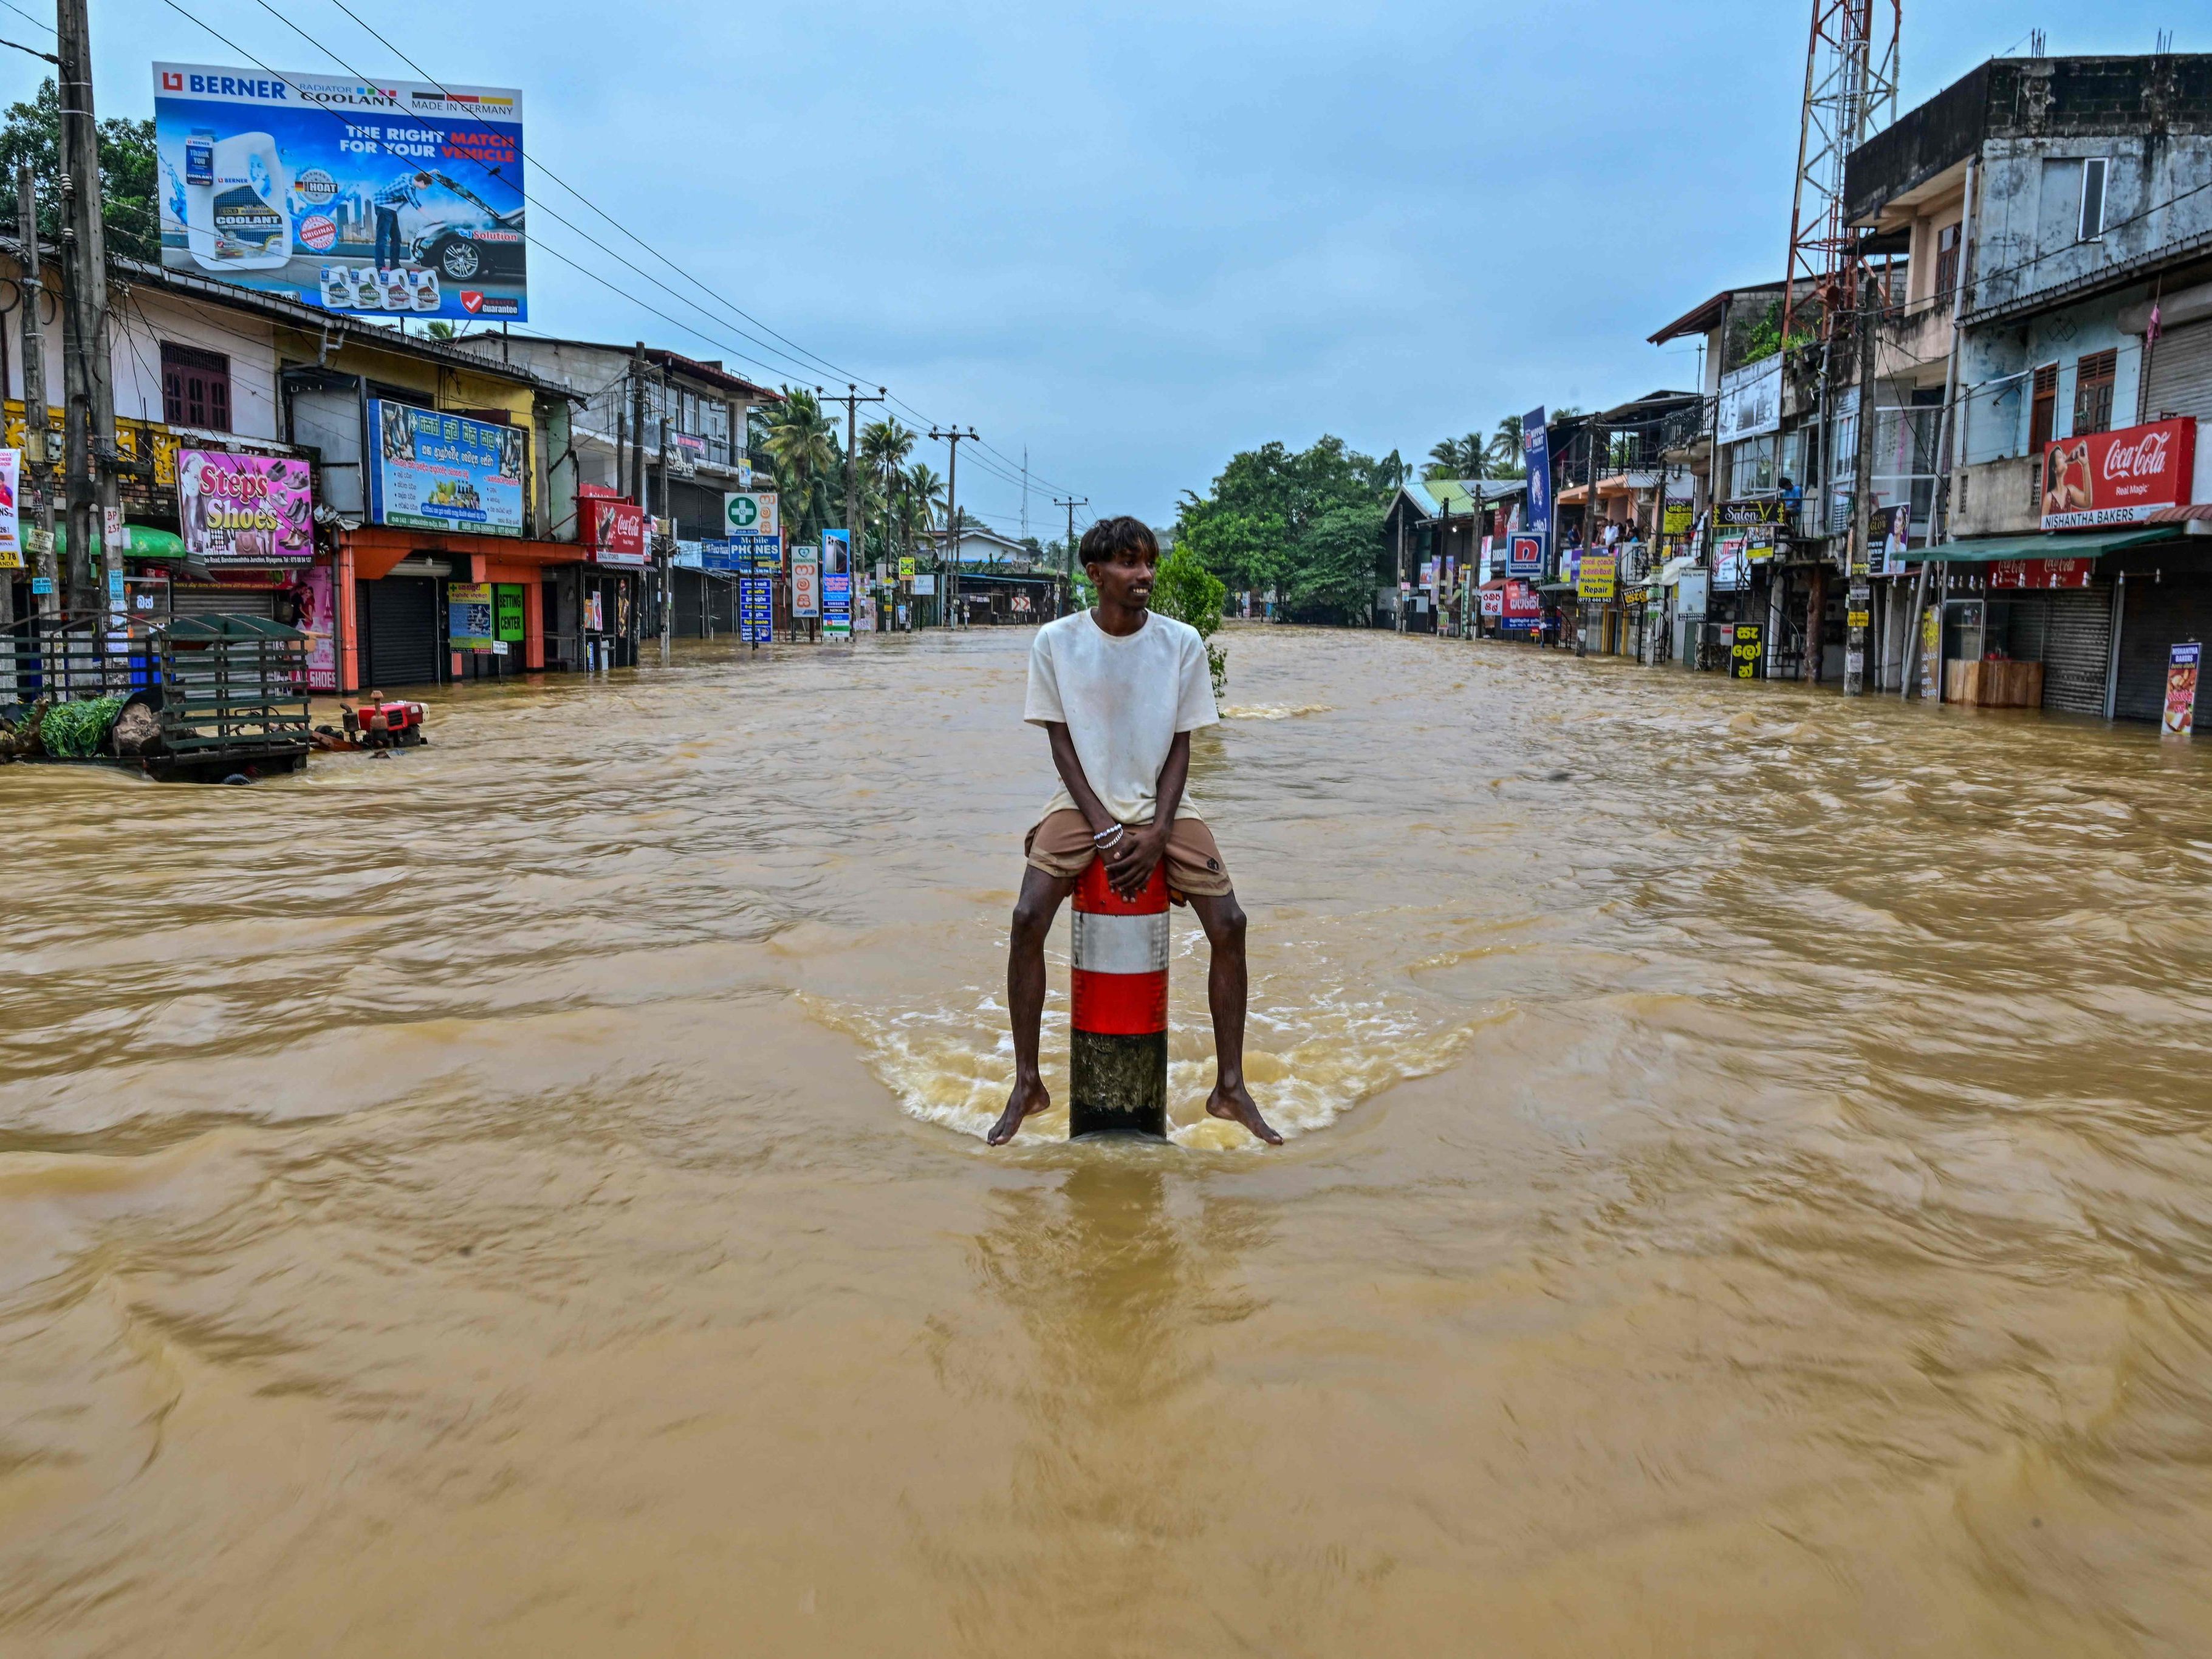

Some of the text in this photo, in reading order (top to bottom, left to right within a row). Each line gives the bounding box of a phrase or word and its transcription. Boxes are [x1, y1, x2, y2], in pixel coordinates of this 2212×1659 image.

[190, 74, 287, 100] BERNER
[300, 83, 352, 94] RADIATOR
[300, 92, 397, 107] COOLANT
[412, 100, 513, 115] MADE IN GERMANY
[346, 125, 515, 148] THE RIGHT MATCH
[340, 139, 515, 163] FOR YOUR VEHICLE
[309, 182, 337, 193] HOAT
[216, 216, 279, 225] COOLANT
[302, 225, 334, 240] ORIGINAL
[473, 230, 518, 241] Solution
[482, 304, 518, 314] Guarantee
[1531, 425, 1544, 437] NIPPON
[1533, 436, 1544, 448] PAINT
[200, 463, 268, 504] Steps
[2116, 483, 2148, 496] Real Magic
[107, 511, 117, 521] BP
[207, 498, 278, 530] Shoes
[1725, 505, 1758, 521] Salon
[2045, 511, 2094, 528] NISHANTHA
[2097, 507, 2134, 524] BAKERS
[108, 525, 120, 534] 237
[1870, 519, 1887, 531] GLOW
[1584, 586, 1608, 595] Repair
[499, 594, 521, 608] BETTING
[500, 615, 521, 630] CENTER
[2172, 646, 2198, 655] NISHANTHA
[310, 671, 336, 688] SHOES
